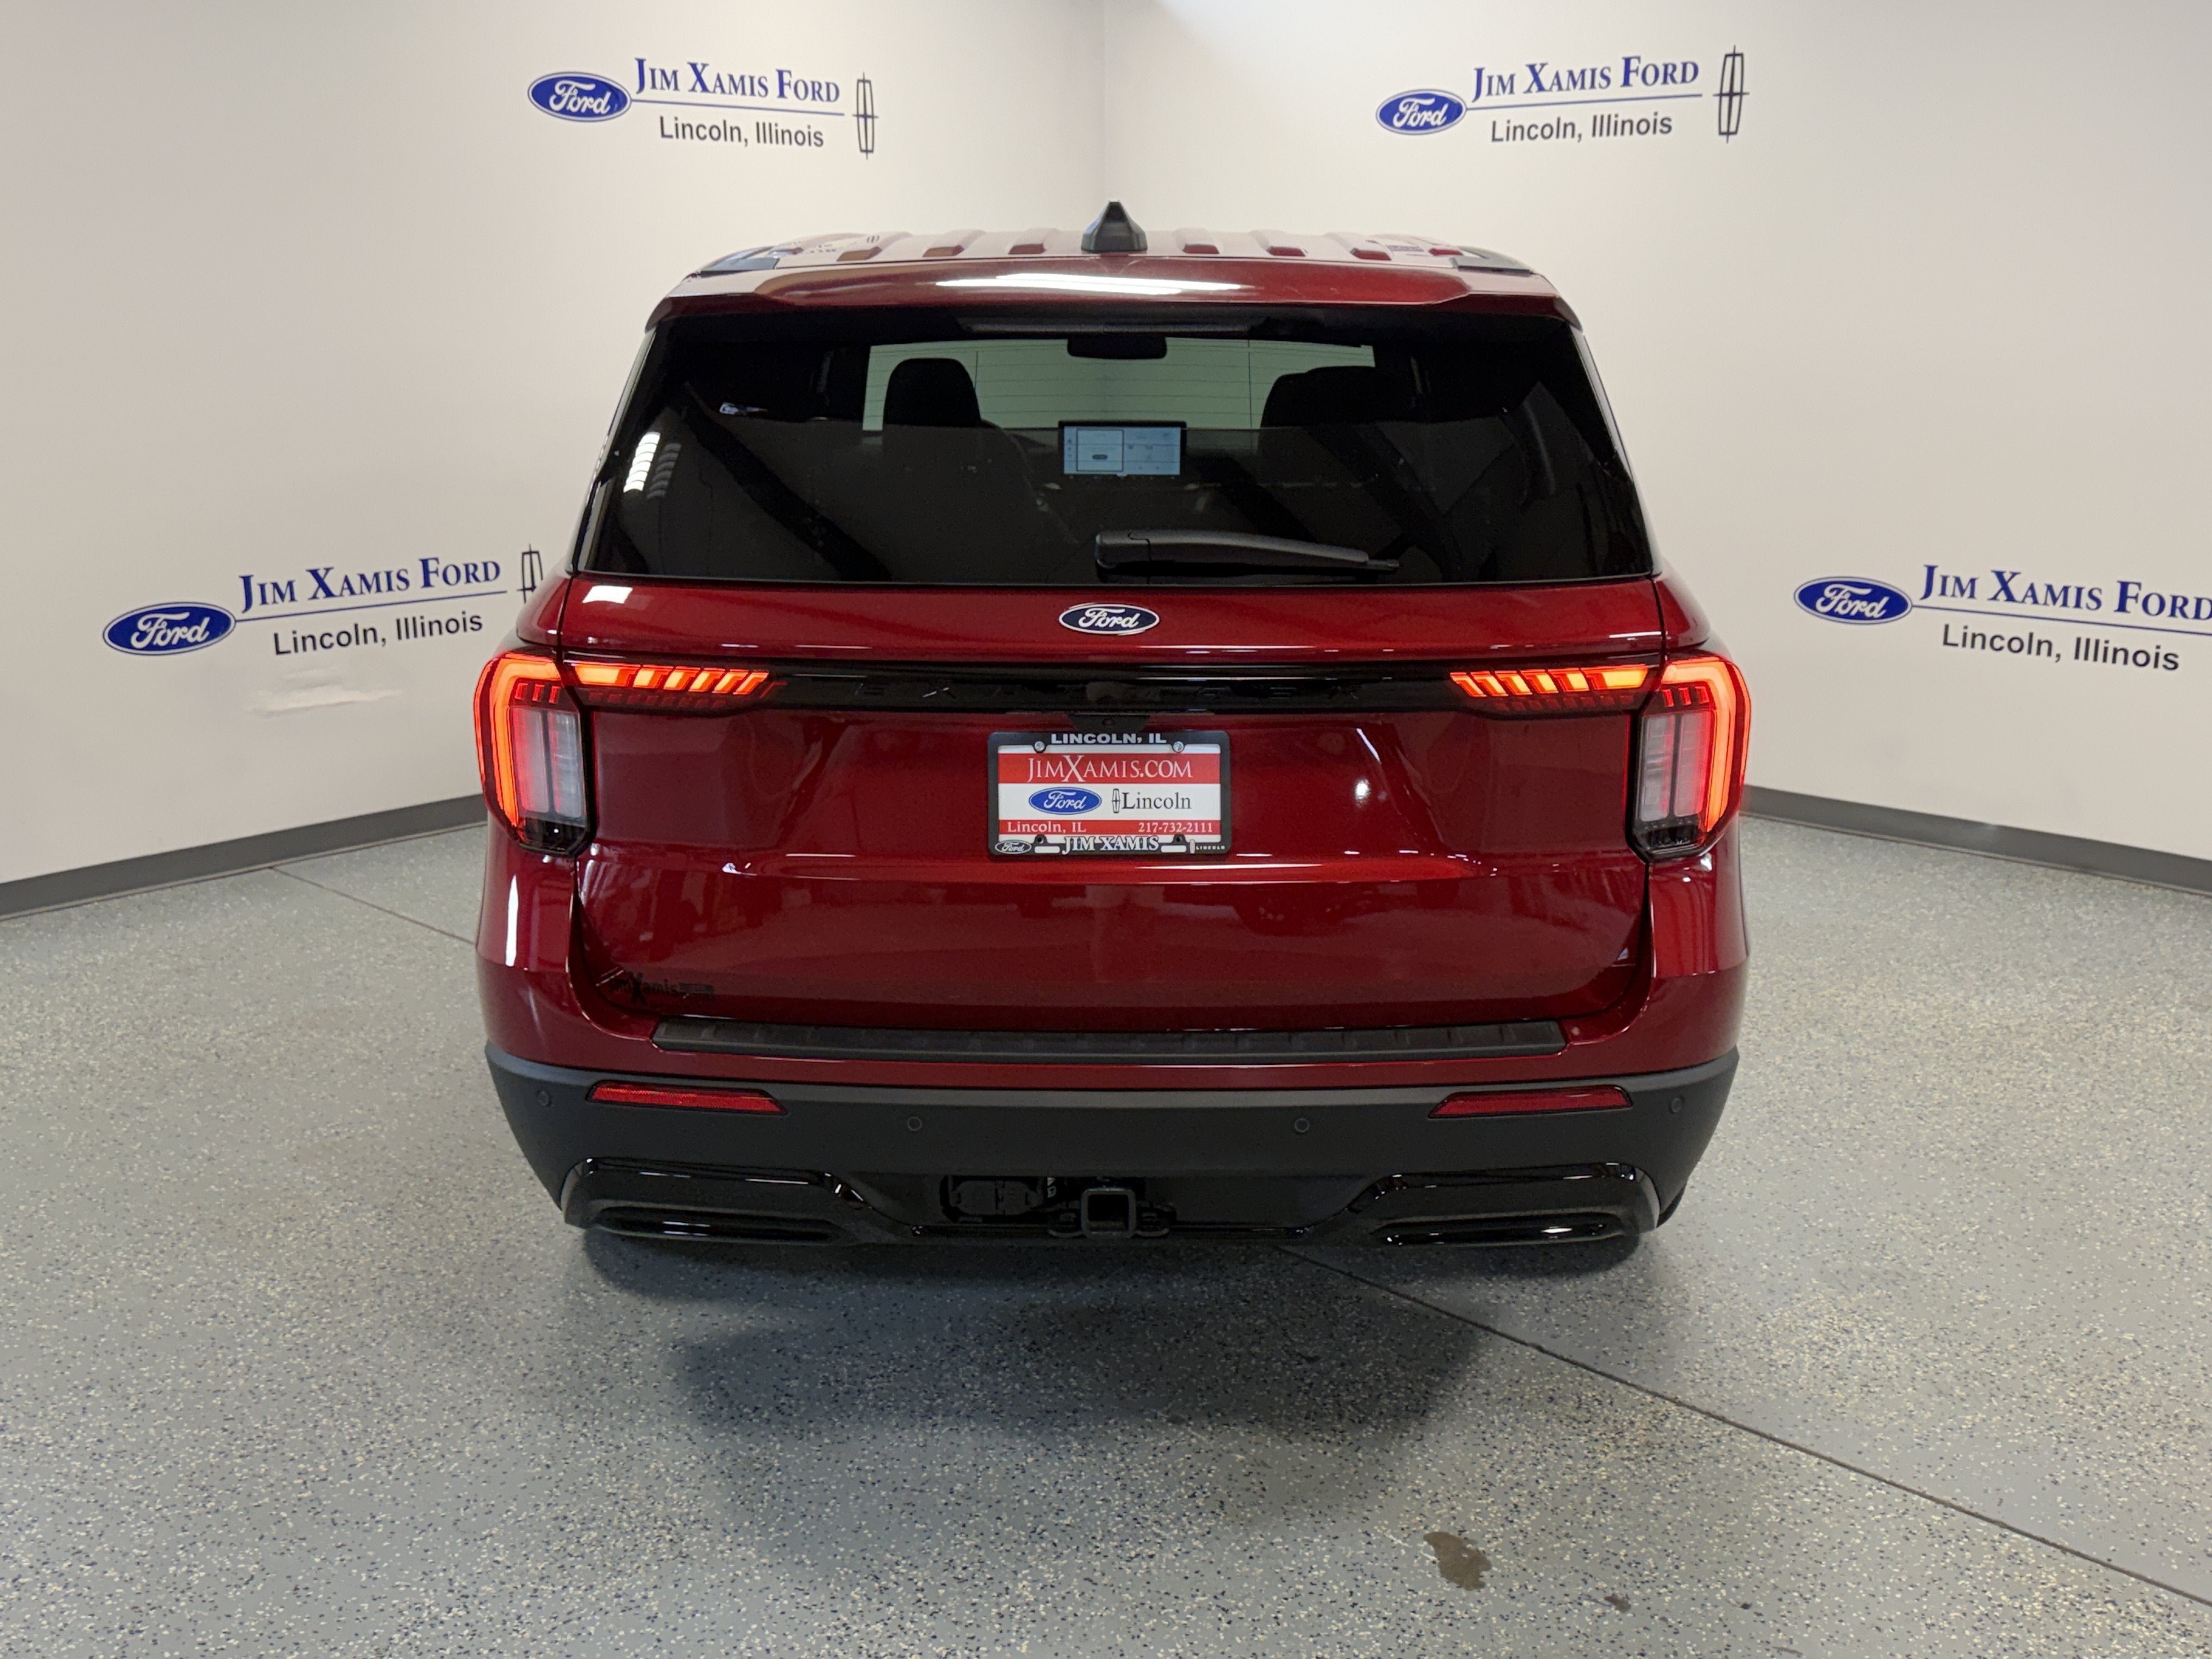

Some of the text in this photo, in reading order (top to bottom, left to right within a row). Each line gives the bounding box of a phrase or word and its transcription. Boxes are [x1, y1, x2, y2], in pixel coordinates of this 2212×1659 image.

[634, 57, 840, 103] JIM XAMIS FORD
[1471, 55, 1699, 103] JIM XAMIS FORD
[549, 80, 611, 114] Ford
[1392, 97, 1448, 128] Ford
[659, 116, 824, 148] Lincoln, Illinois
[1491, 111, 1673, 143] Lincoln, Illinois
[239, 557, 501, 614] JIM XAMIS FORD
[1815, 583, 1887, 619] Ford
[1919, 565, 2212, 621] JIM XAMIS FORD
[131, 612, 210, 649] Ford
[273, 611, 483, 656] Lincoln, Illinois
[1078, 607, 1141, 628] Ford
[1942, 623, 2179, 672] Lincoln, Illinois
[1051, 733, 1166, 744] LINCOLN, IL
[1027, 755, 1193, 782] JIMXAMIS.COM
[1043, 791, 1086, 810] Ford
[1122, 792, 1191, 809] Lincoln
[1007, 821, 1086, 833] Lincoln, IL
[1138, 822, 1212, 833] 217-732-2111
[1001, 842, 1025, 852] Ford
[1062, 836, 1159, 855] JIM XAMIS
